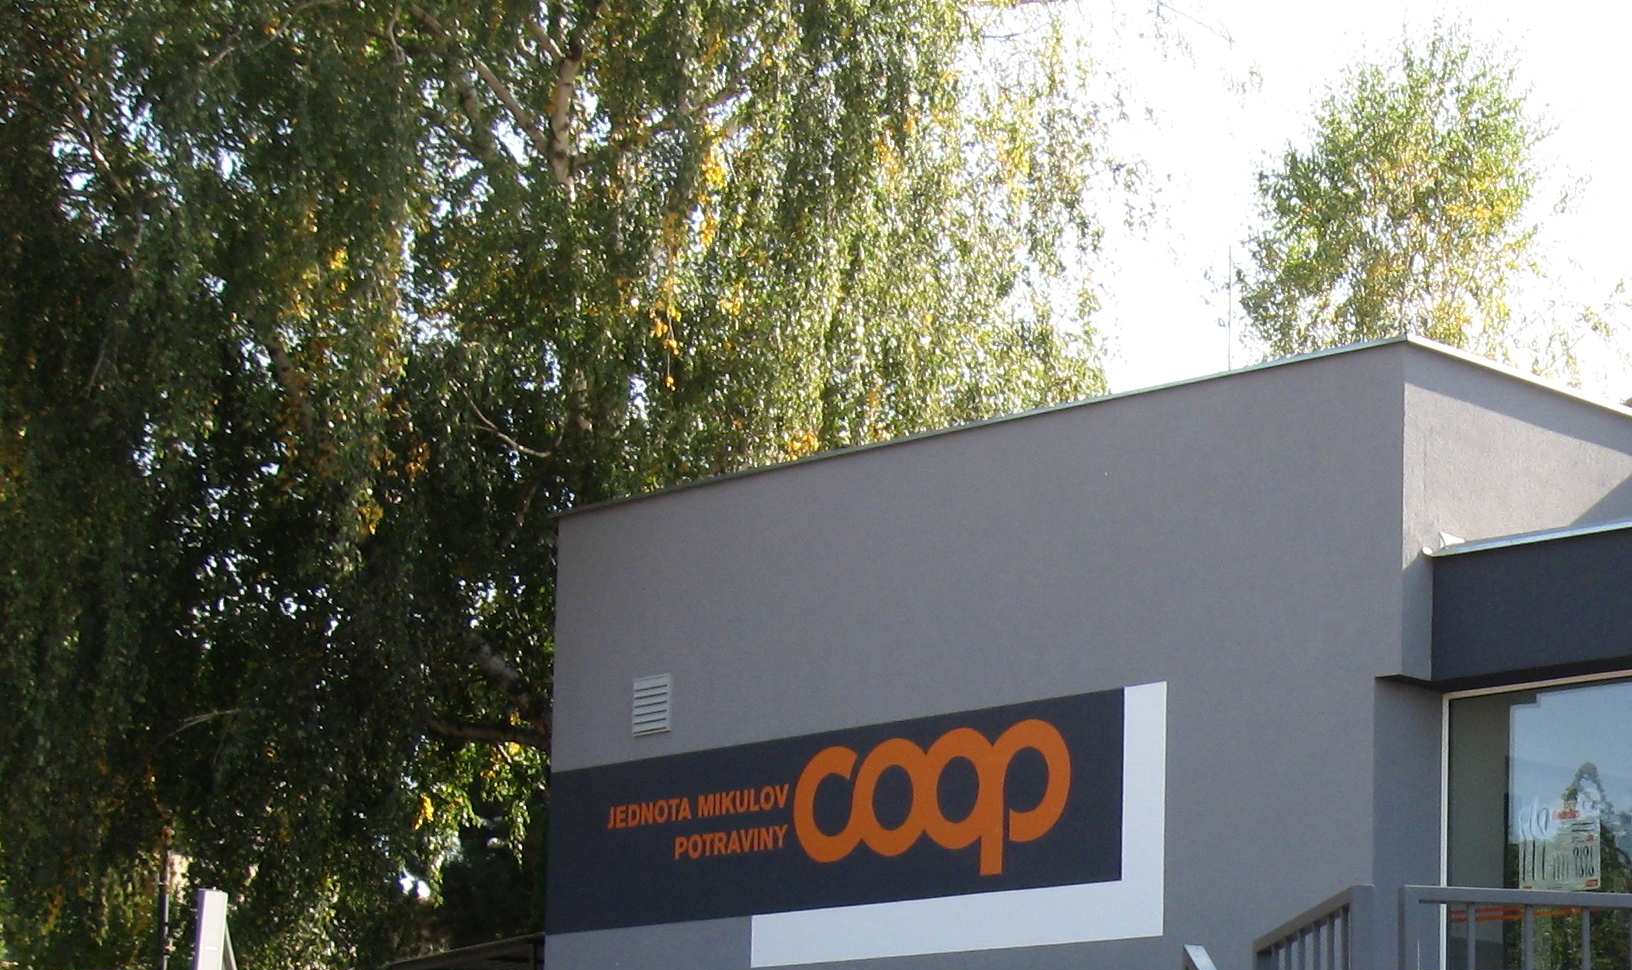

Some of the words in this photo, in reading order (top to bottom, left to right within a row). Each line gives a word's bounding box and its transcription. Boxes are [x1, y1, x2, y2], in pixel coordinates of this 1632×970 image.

[607, 797, 692, 829] JEDNOTA
[697, 783, 790, 818] MIKULOV
[793, 718, 1072, 876] coop
[673, 824, 789, 860] POTRAVINY
